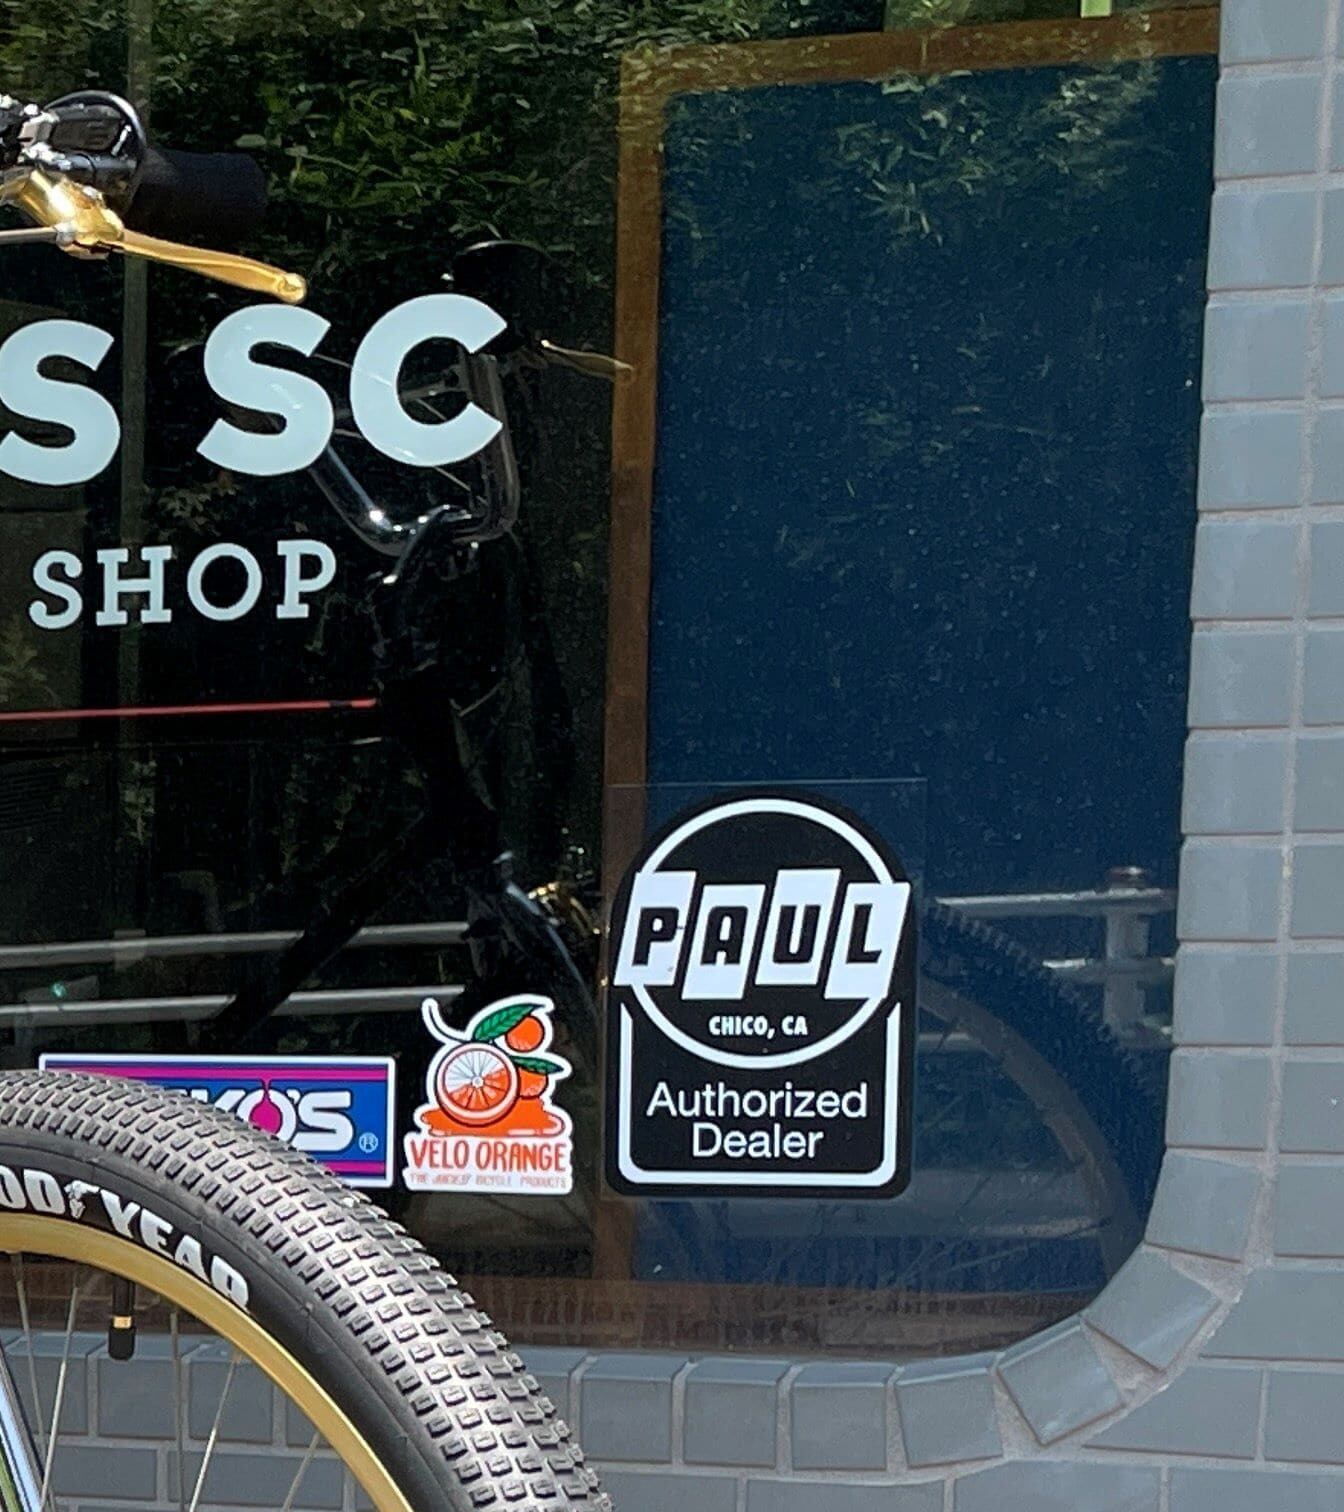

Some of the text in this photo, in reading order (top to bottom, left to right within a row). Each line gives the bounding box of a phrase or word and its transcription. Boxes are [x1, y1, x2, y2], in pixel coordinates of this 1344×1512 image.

[196, 292, 509, 477] SC
[28, 539, 337, 630] SHOP
[708, 1015, 809, 1040] CHICO, CA
[645, 1081, 869, 1119] Authorized
[409, 1138, 567, 1173] VELO ORANGE
[692, 1122, 825, 1160] Dealer
